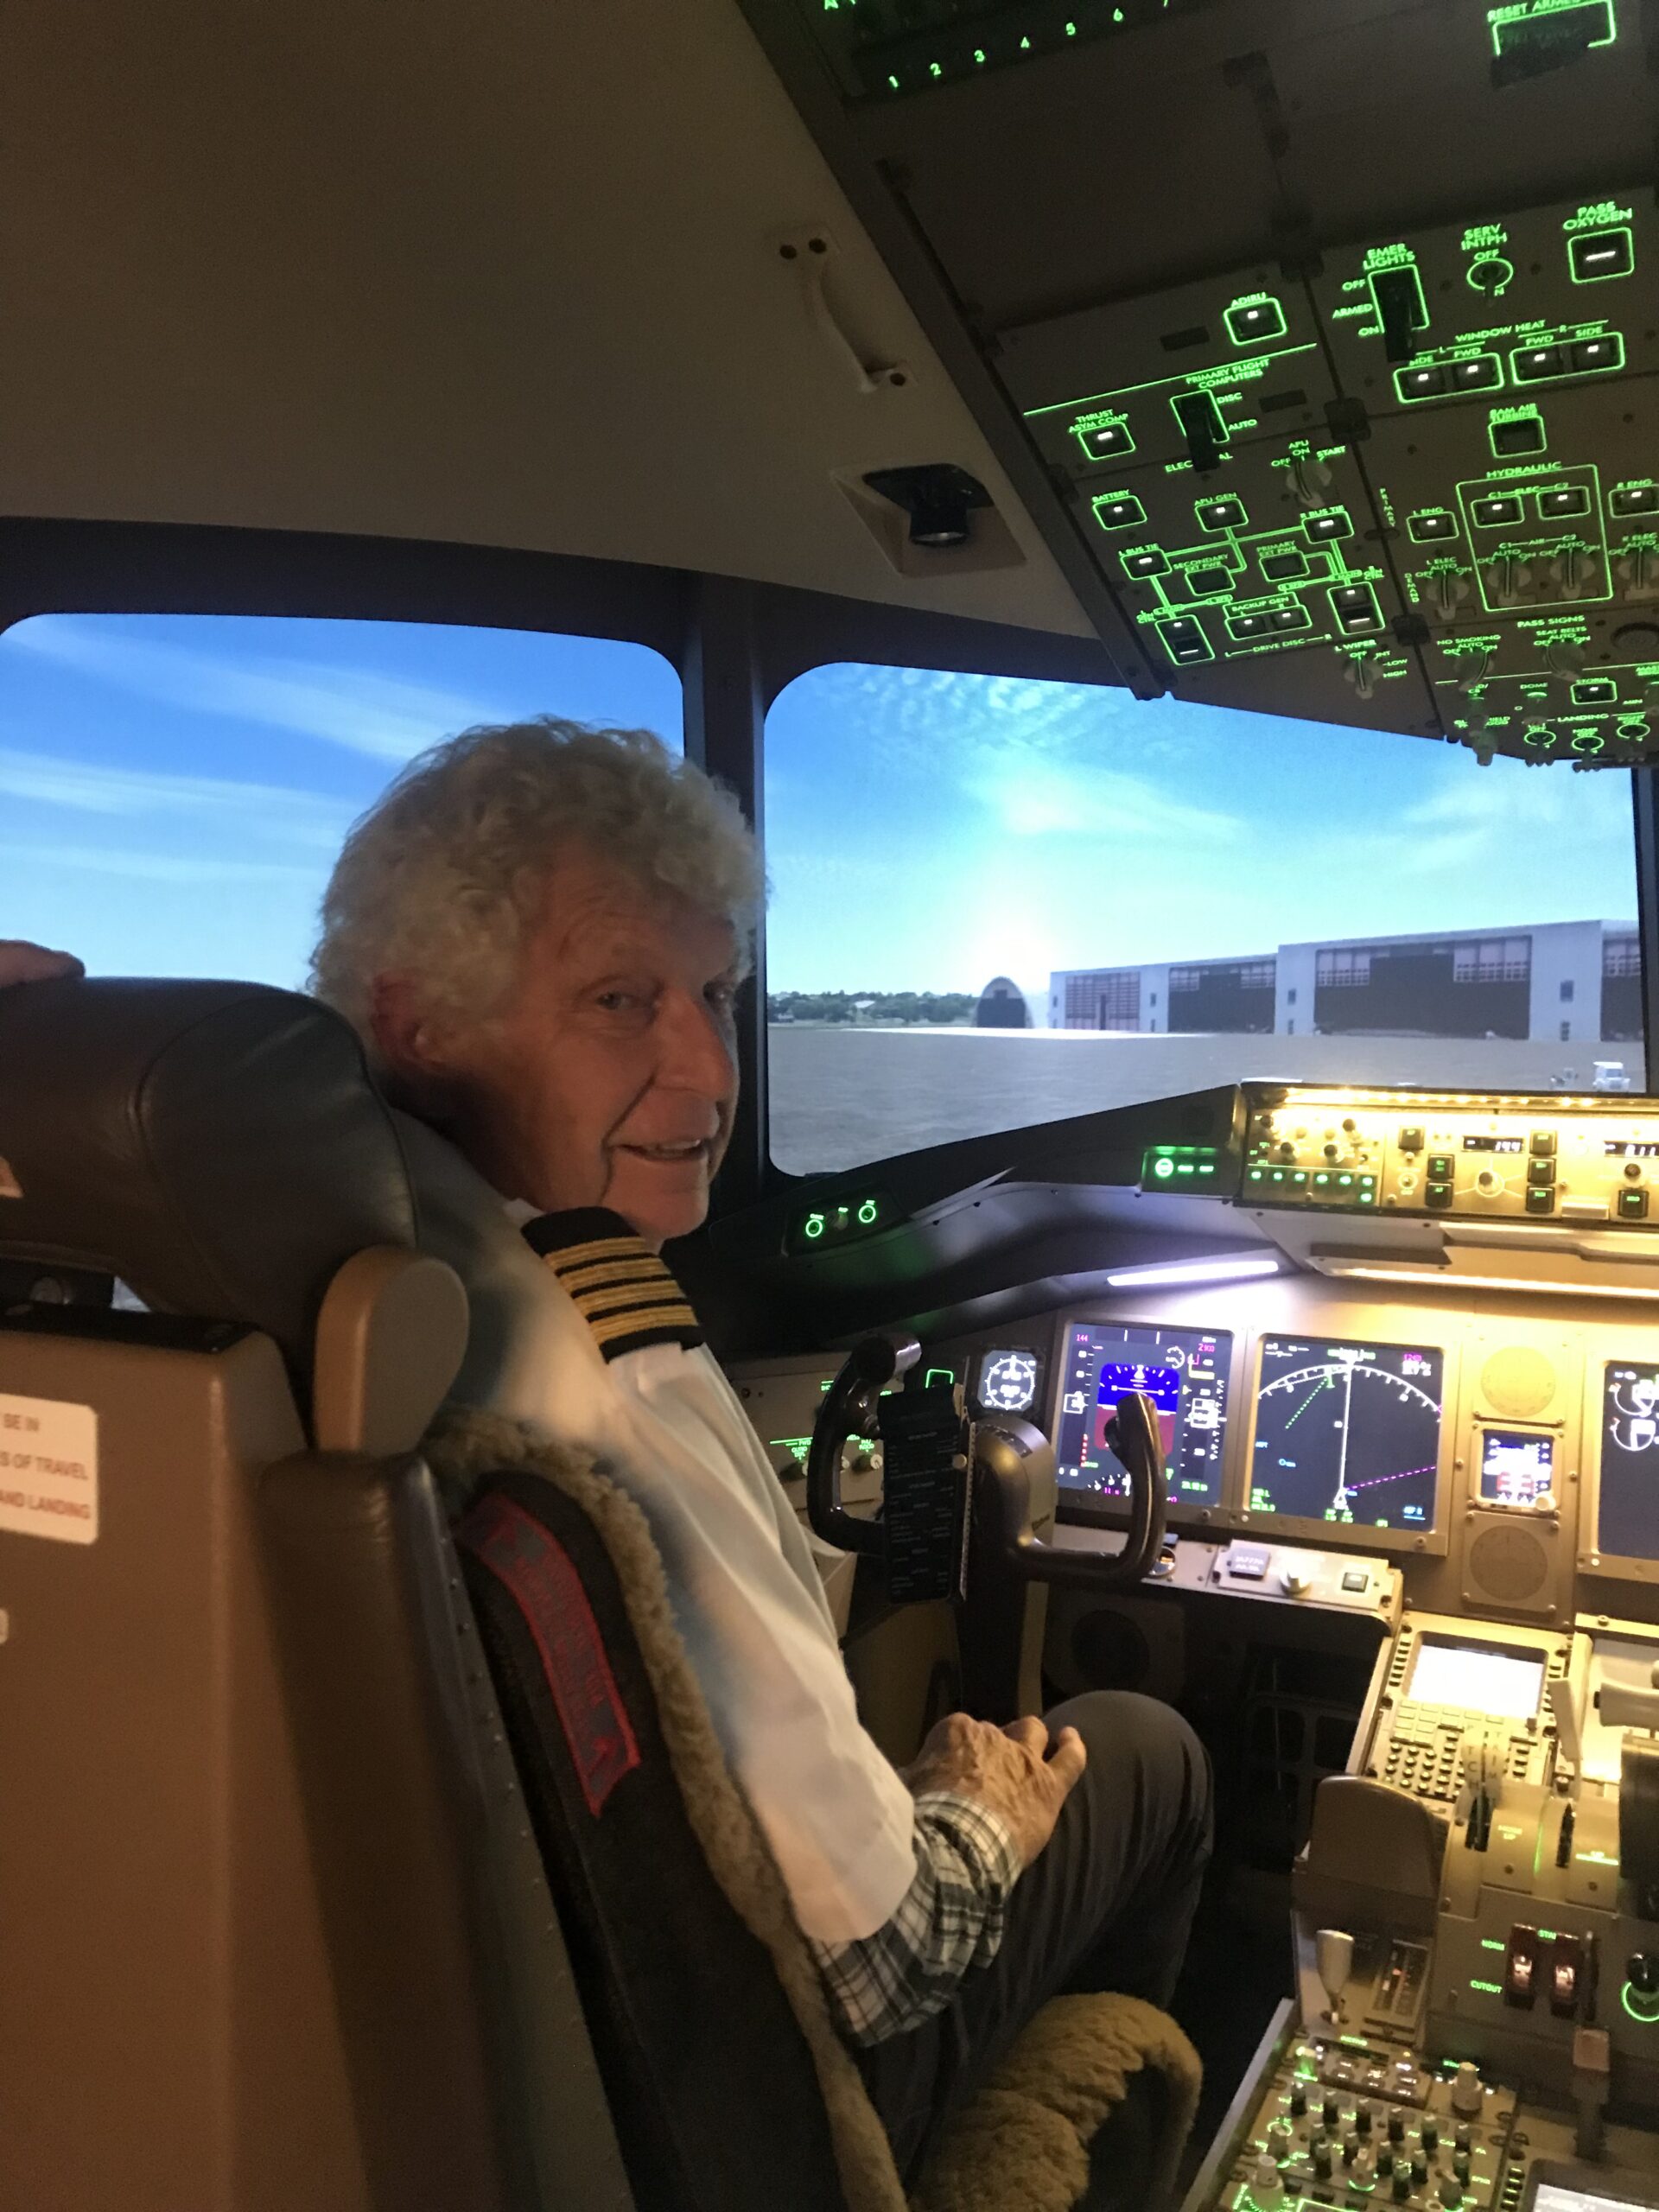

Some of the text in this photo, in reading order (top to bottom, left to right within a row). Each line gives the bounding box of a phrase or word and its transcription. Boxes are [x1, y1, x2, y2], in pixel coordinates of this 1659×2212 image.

[889, 8, 1123, 88] 1 2 3 4 5 6
[1577, 200, 1616, 218] PASS
[1562, 207, 1633, 231] OXYGEN
[1464, 223, 1502, 240] SERV
[1461, 232, 1509, 251] INTPH
[1367, 243, 1408, 260] EMER
[1473, 249, 1500, 261] OFF
[1363, 251, 1416, 270] LIGHTS
[1341, 279, 1366, 292] OFF
[1230, 292, 1268, 308] ADIRU
[1332, 303, 1374, 320] ARMED
[1357, 326, 1380, 337] ON
[1455, 320, 1547, 343] WINDOW HEAT
[1454, 346, 1482, 359] FWD
[1526, 334, 1554, 346] FWD
[1575, 326, 1605, 338] SIDE
[1185, 358, 1270, 385] PRIMARY FLIGHT
[1198, 369, 1264, 391] COMPUTERS
[1217, 391, 1243, 405] DISC
[1067, 412, 1129, 434] ASYM COMP
[1075, 408, 1114, 424] THRUST
[1228, 418, 1259, 431] AUTO
[1288, 439, 1309, 448] APU
[1292, 447, 1311, 456] ON
[1316, 445, 1346, 459] START
[1271, 457, 1292, 467] OFF
[1486, 461, 1562, 479] HYDRAULIC
[1091, 489, 1130, 504] BATTERY
[1194, 492, 1237, 506] APU GEN
[1309, 508, 1328, 518] BUS
[1329, 505, 1345, 513] TIE
[1126, 546, 1143, 556] BUS
[1256, 540, 1296, 553] PRIMARY
[1173, 554, 1229, 570] SECONDARY
[1433, 556, 1458, 565] ELEC
[1493, 549, 1522, 560] AUTO
[1230, 596, 1290, 613] BACKUP GEN
[1517, 615, 1586, 629] PASS SIGNS
[1252, 643, 1281, 653] DRIVE
[1281, 638, 1306, 649] DISC
[1343, 639, 1377, 650] WIPER
[1455, 634, 1502, 645] SMOKING
[1382, 670, 1408, 679] HIGH
[1557, 714, 1610, 723] LANDING
[3, 1413, 40, 1433] BE IN
[13, 1453, 32, 1470] OF
[35, 1456, 89, 1482] TRAVEL
[28, 1494, 91, 1520] LANDING
[1481, 1939, 1505, 1951] NORM
[1470, 1980, 1503, 1993] CUTOUT
